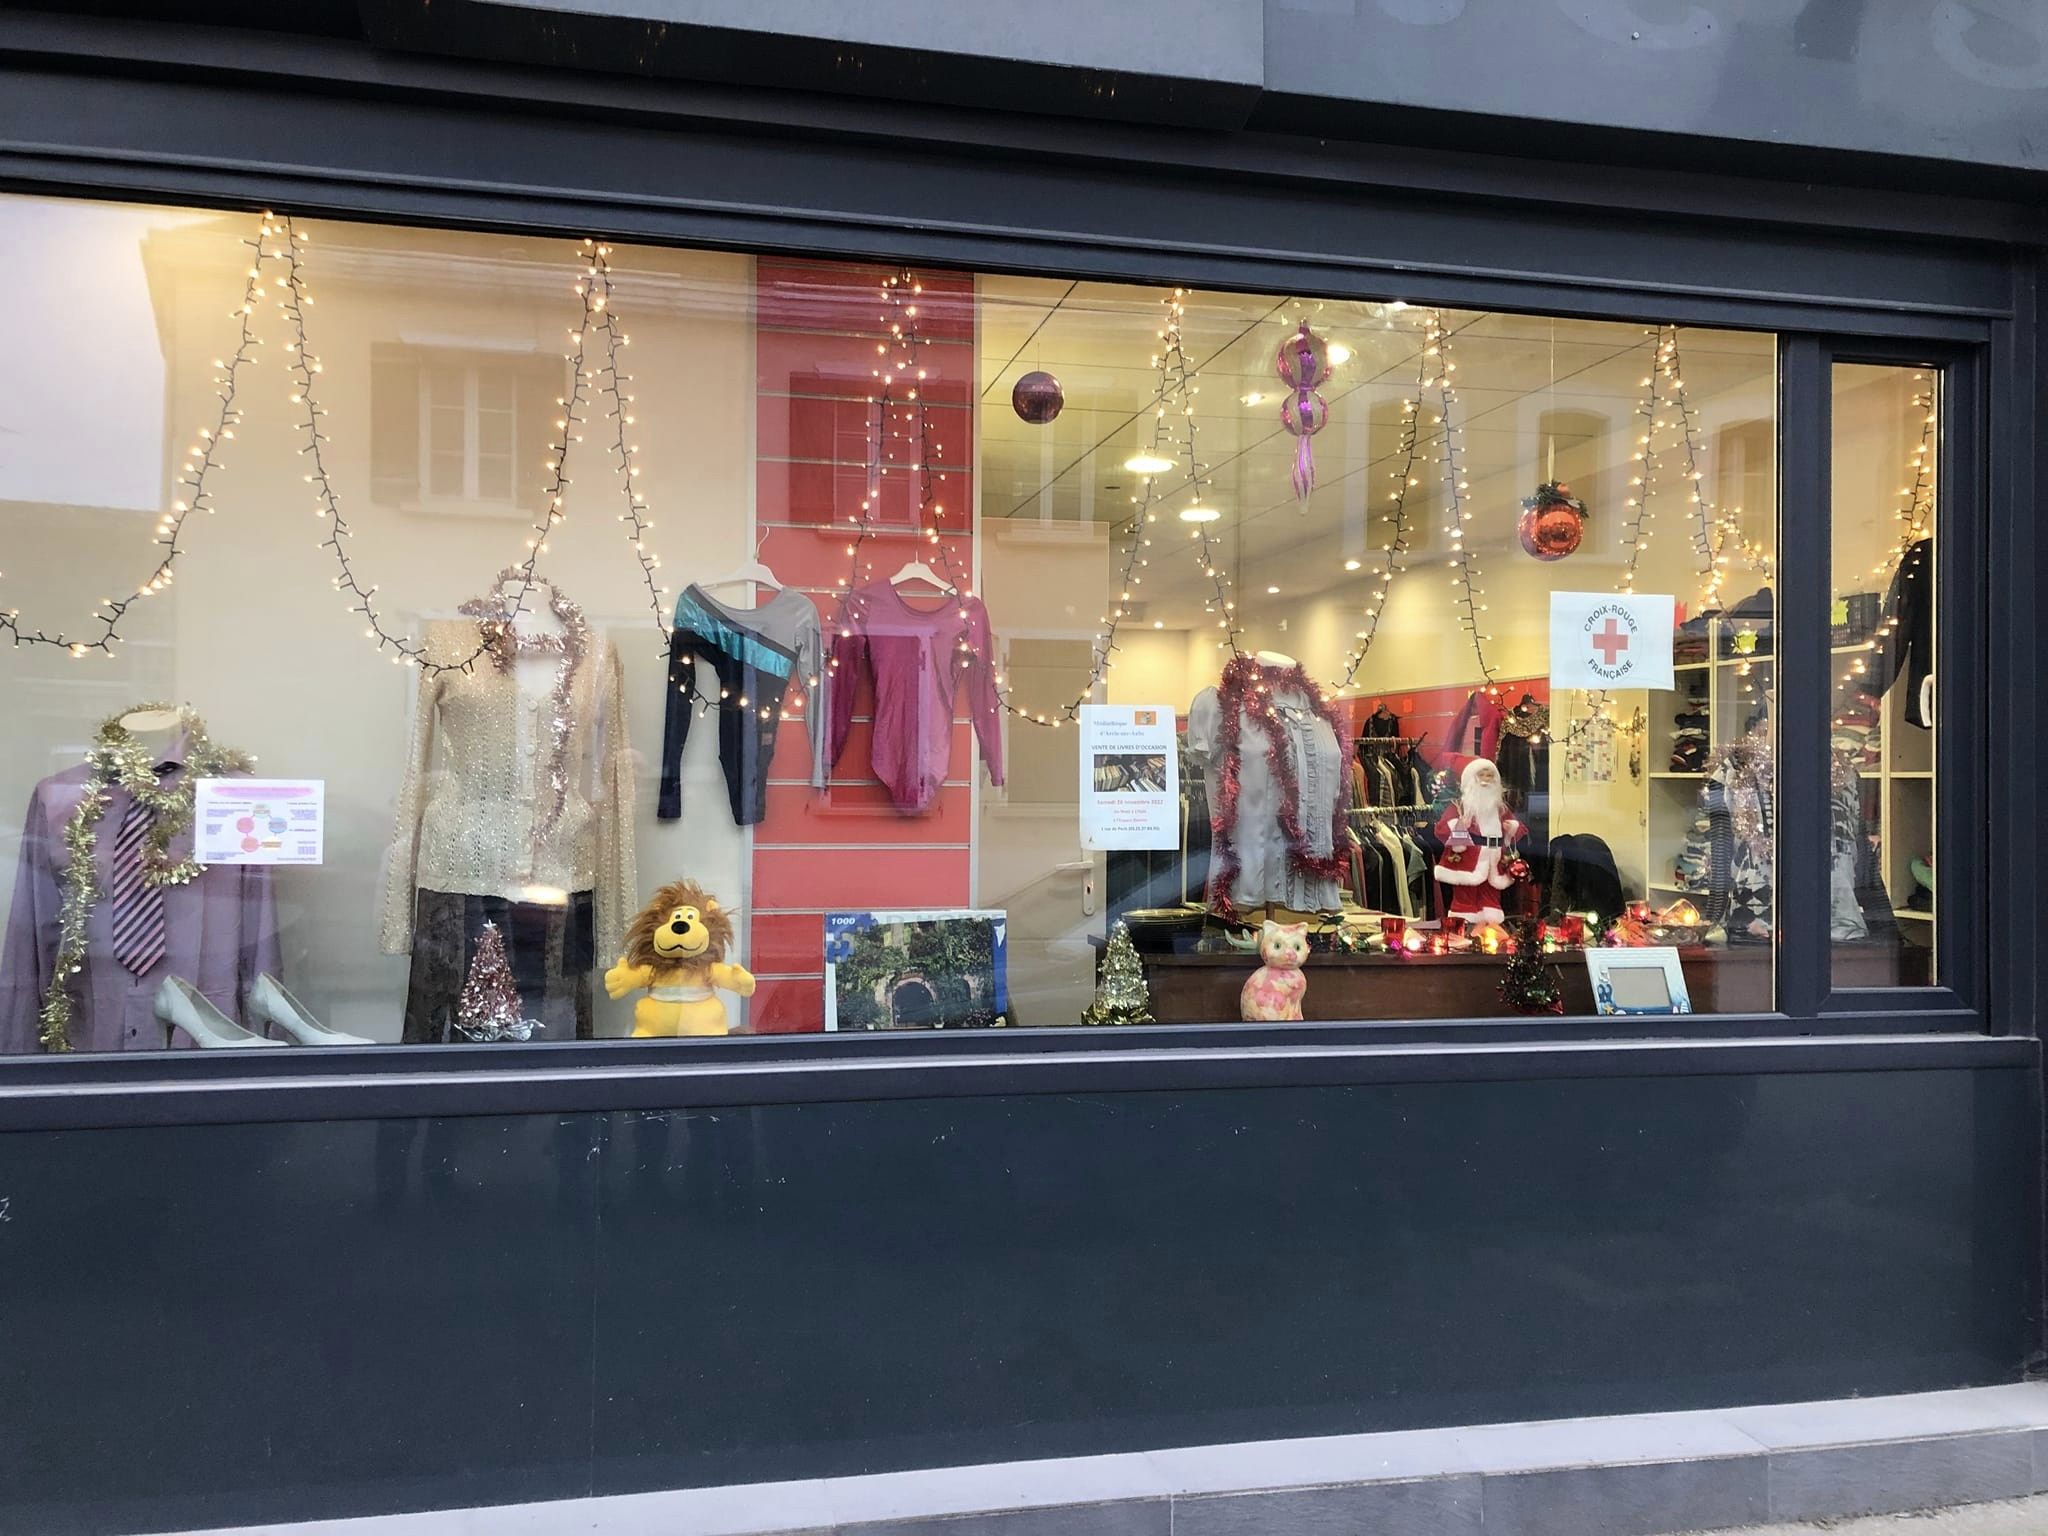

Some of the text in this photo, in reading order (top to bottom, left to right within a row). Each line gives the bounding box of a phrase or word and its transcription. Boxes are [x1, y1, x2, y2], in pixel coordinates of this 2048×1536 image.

[1584, 604, 1638, 634] CROIX-ROUGE
[1588, 658, 1633, 680] FRANÇAISE
[831, 917, 856, 925] 1000
